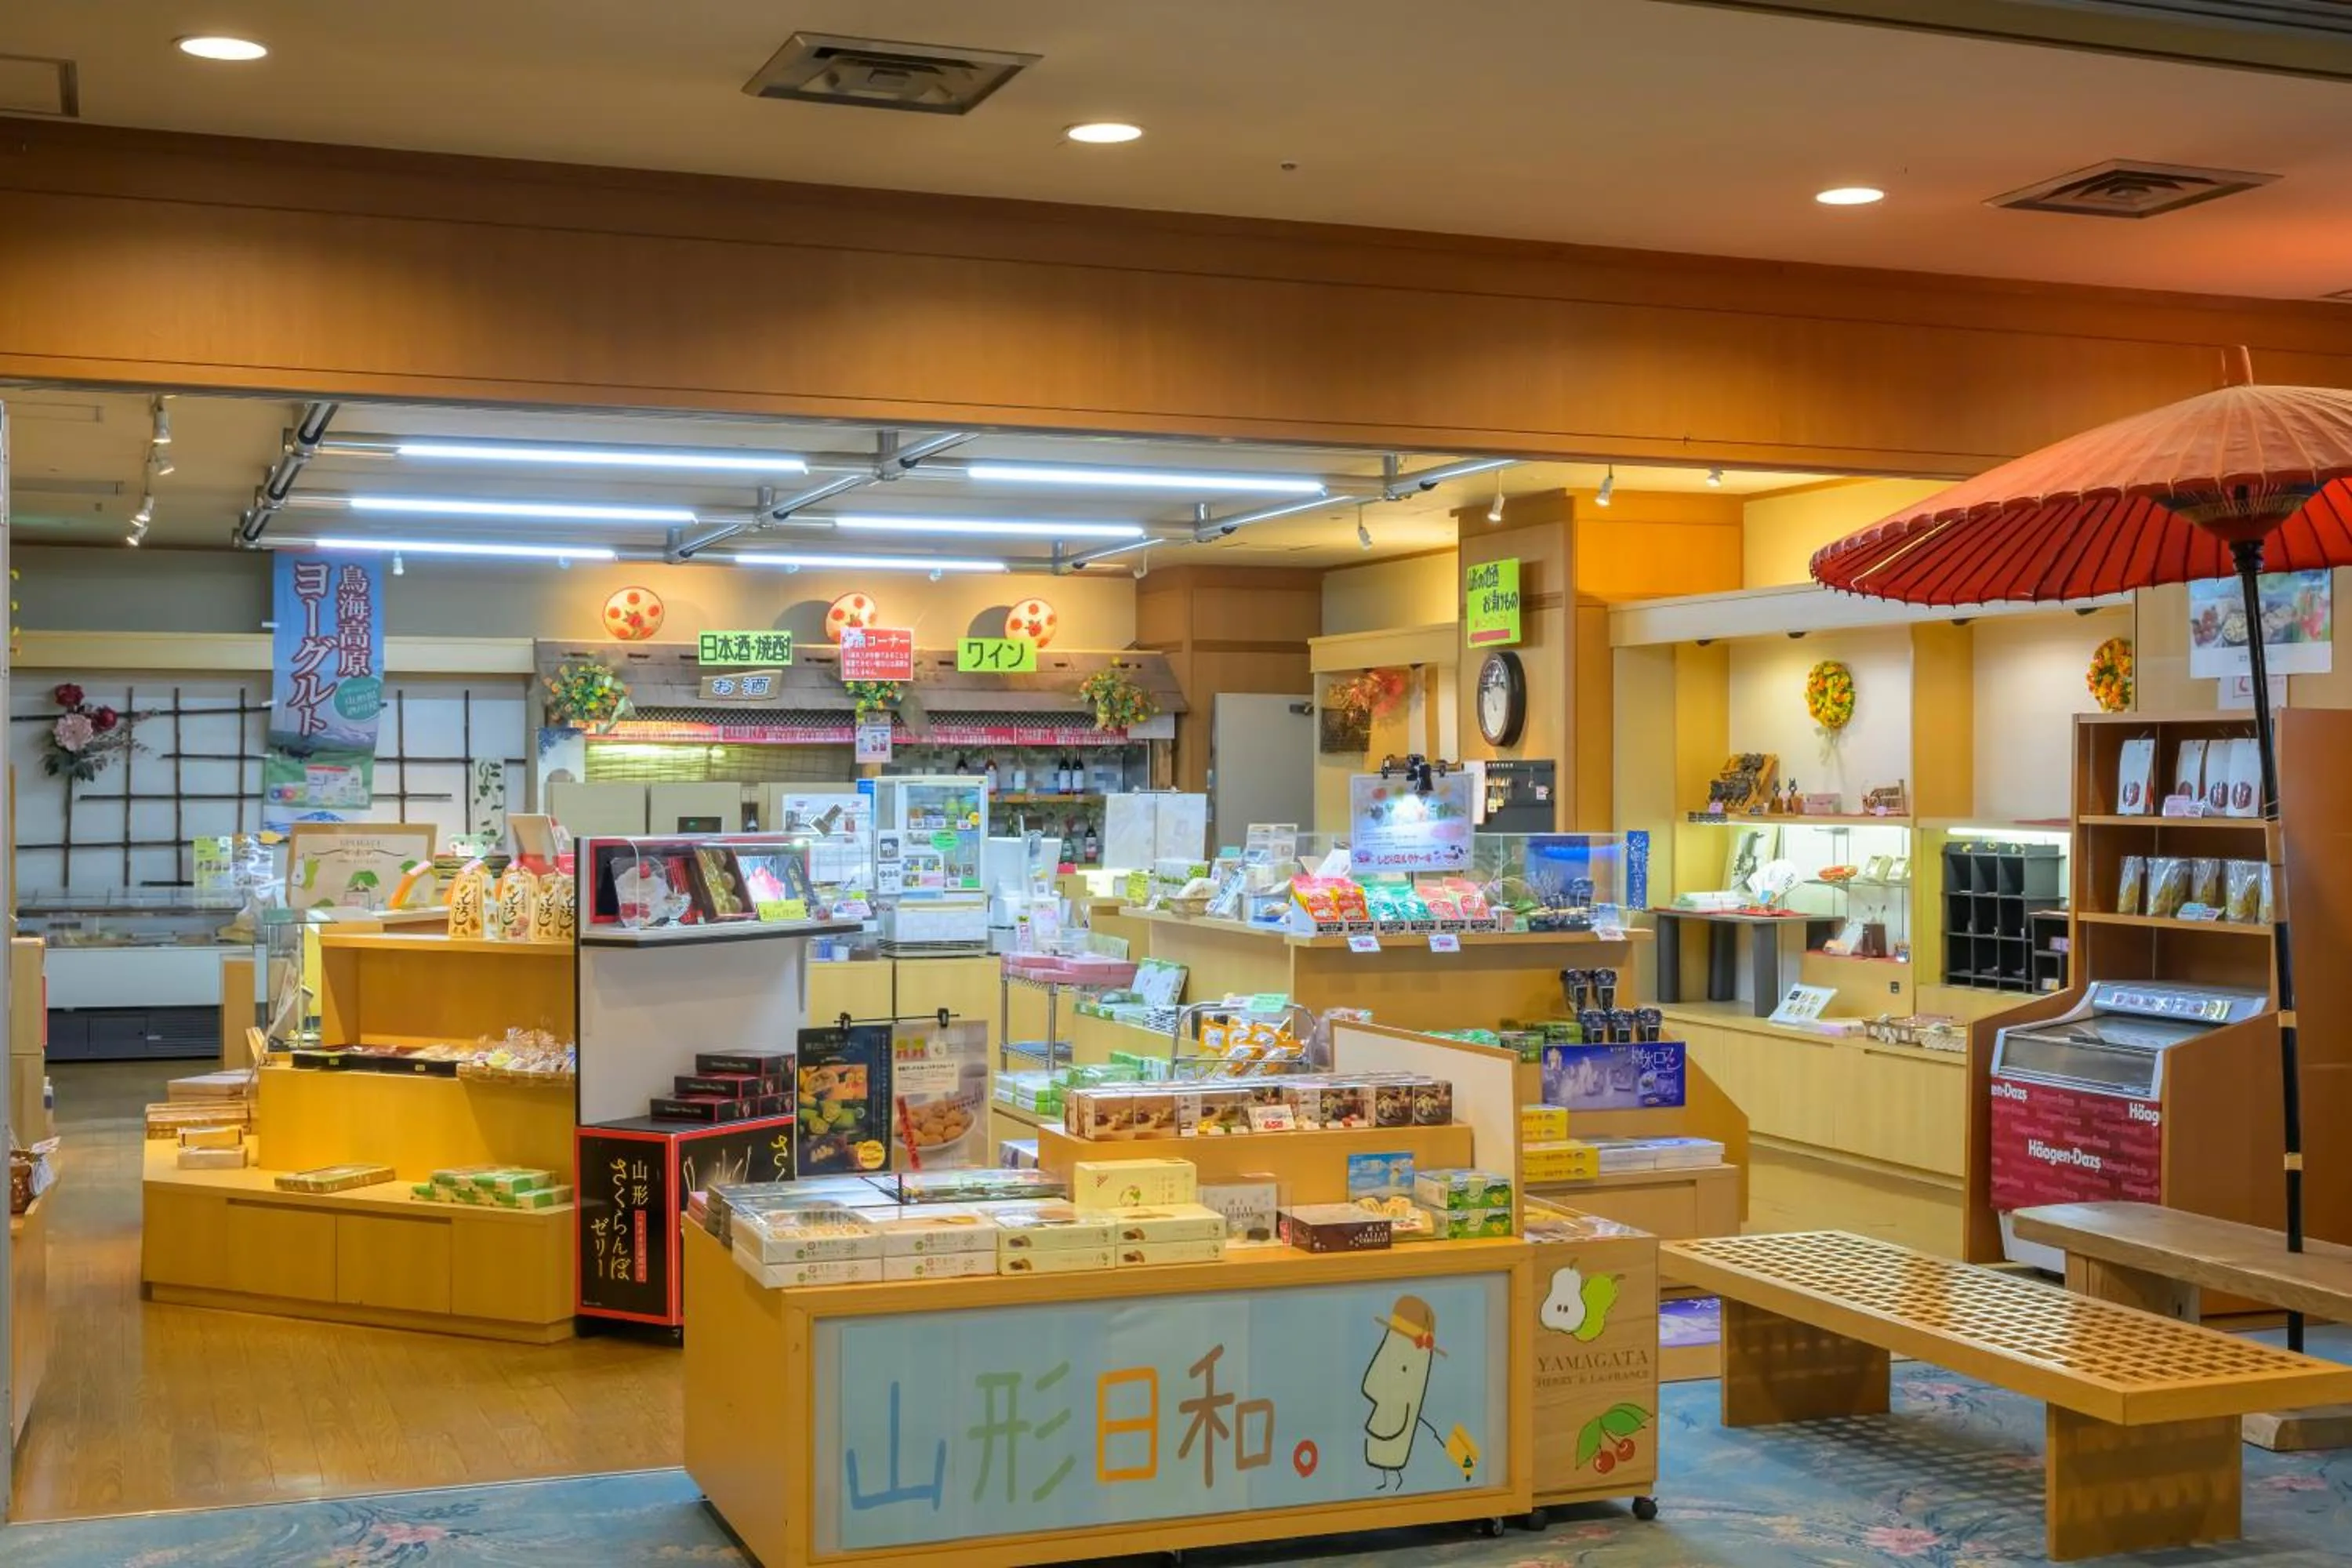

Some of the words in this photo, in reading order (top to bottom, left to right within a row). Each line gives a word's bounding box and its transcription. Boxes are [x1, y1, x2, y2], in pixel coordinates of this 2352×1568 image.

[336, 564, 372, 678] 鳥海高原
[287, 561, 337, 738] ヨーグルト
[967, 641, 1025, 669] ワイン
[2027, 1138, 2103, 1173] Häagen-Dazs
[631, 1160, 650, 1206] 山形
[609, 1157, 632, 1282] さくらんぼ
[590, 1217, 609, 1278] ゼリー
[1537, 1349, 1648, 1373] YAMAGATA
